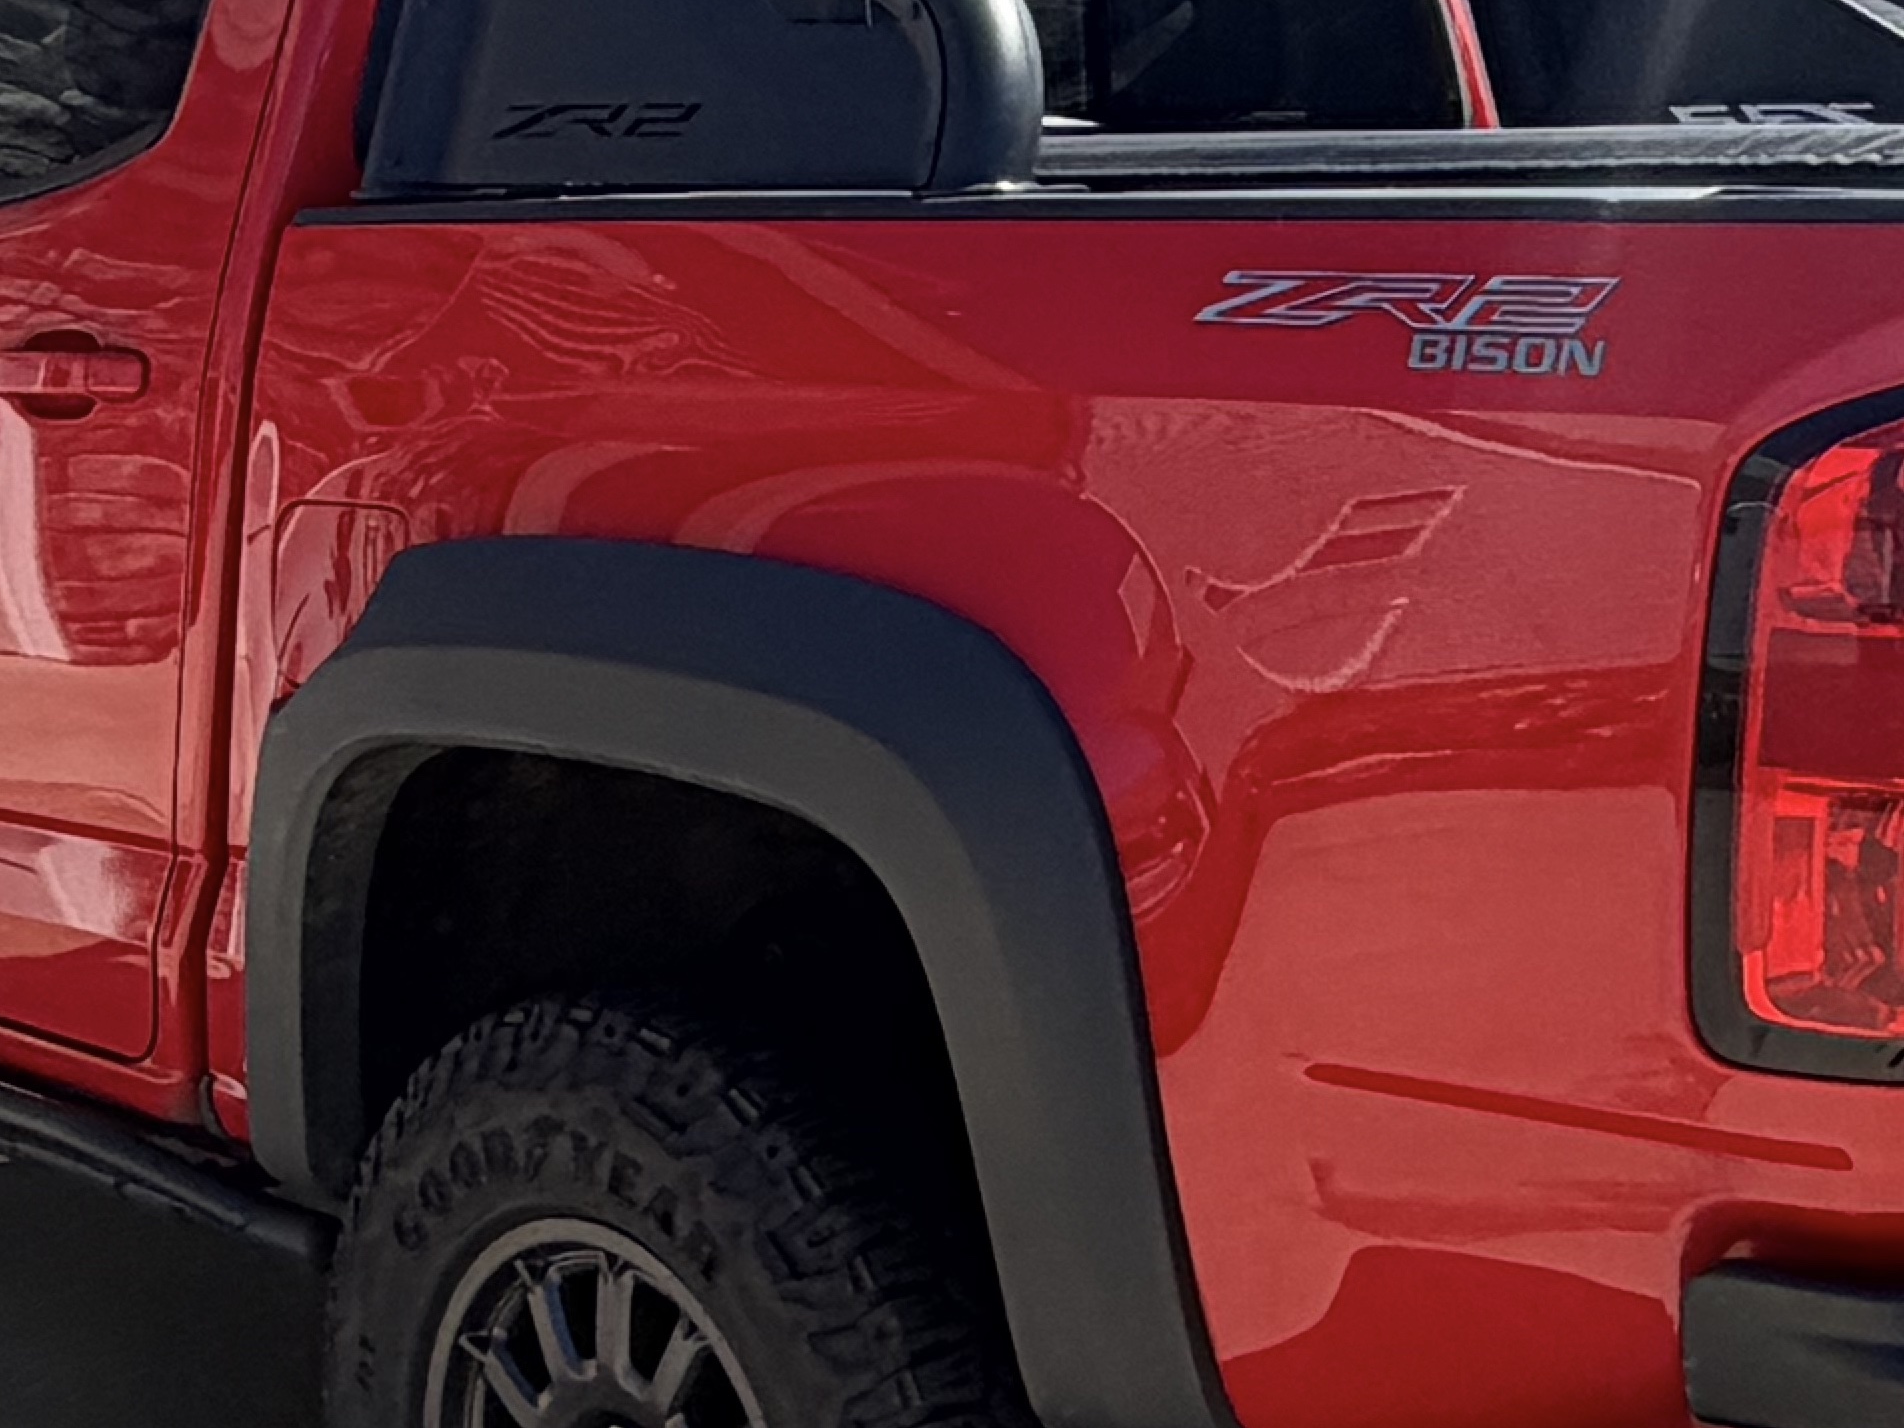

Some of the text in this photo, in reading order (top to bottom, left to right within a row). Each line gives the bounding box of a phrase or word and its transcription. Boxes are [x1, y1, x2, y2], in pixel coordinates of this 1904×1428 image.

[493, 102, 702, 138] ZR2
[1193, 270, 1621, 335] ZR2
[1407, 334, 1605, 376] BISON
[393, 1114, 720, 1282] GOODYEAR
